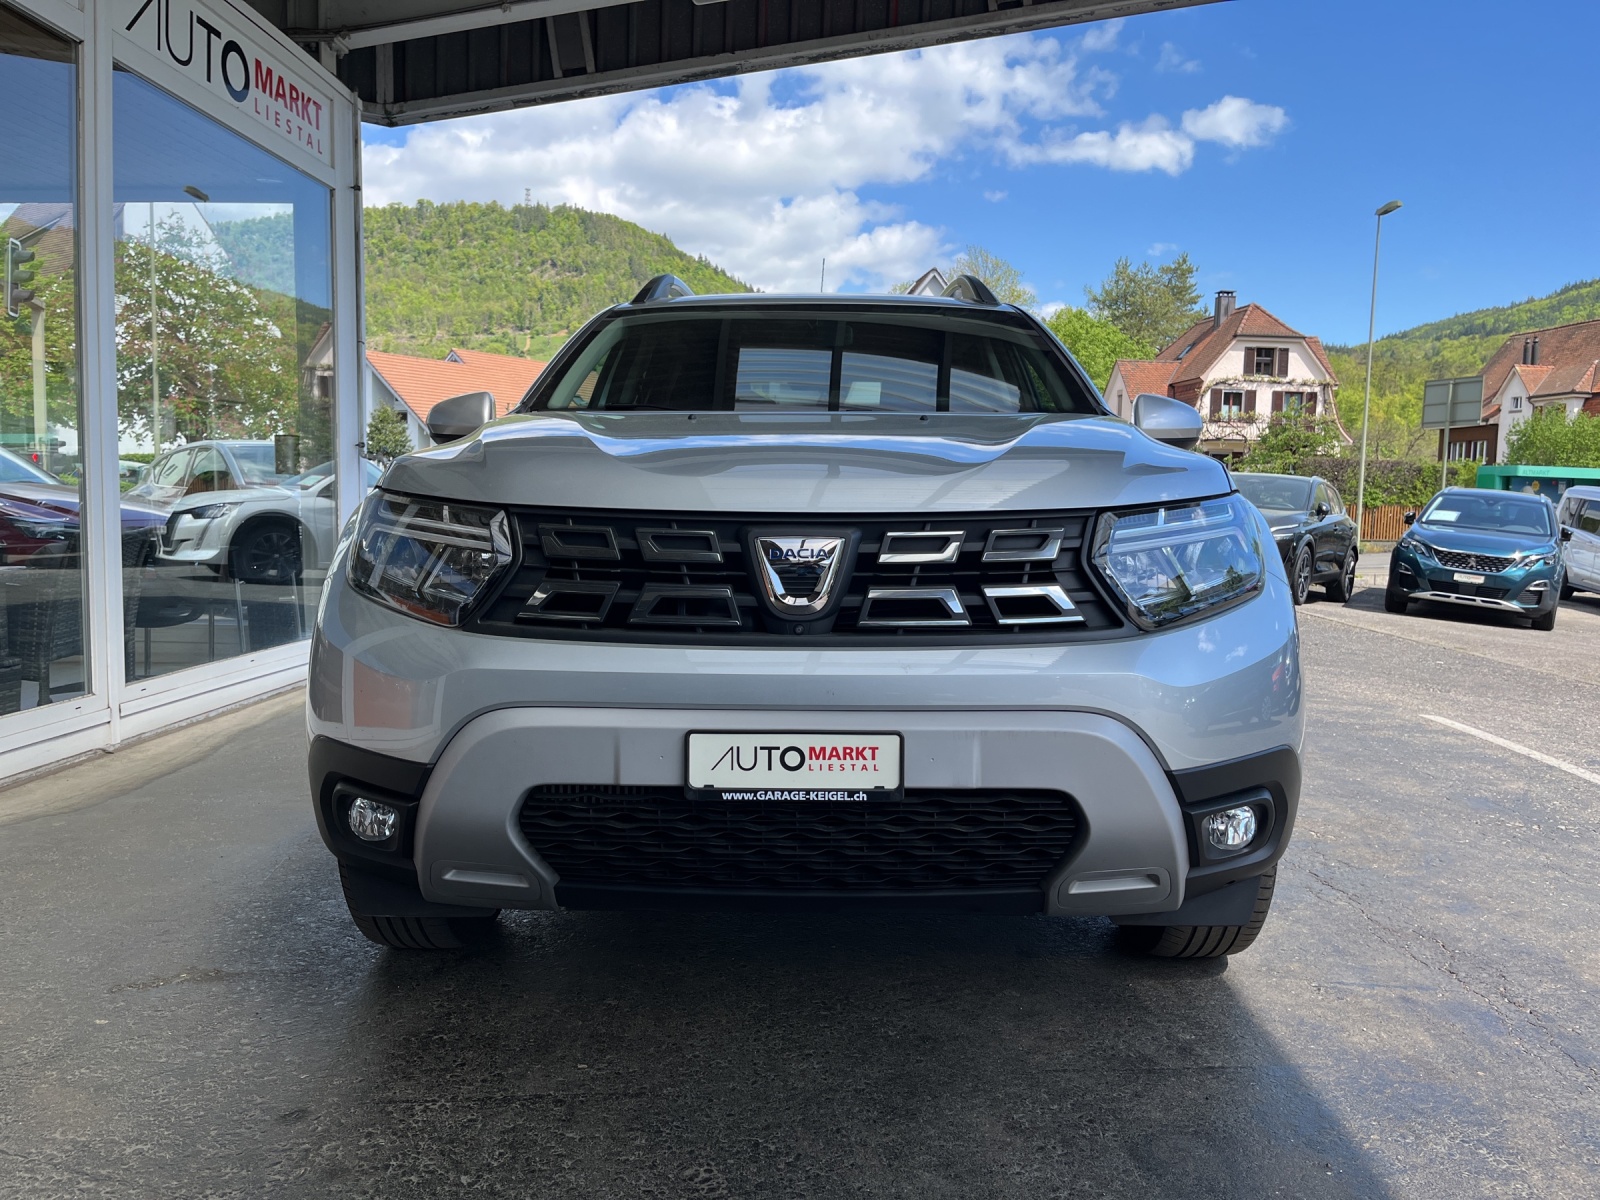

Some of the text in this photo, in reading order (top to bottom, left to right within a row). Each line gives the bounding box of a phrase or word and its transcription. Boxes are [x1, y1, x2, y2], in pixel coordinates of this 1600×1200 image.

[254, 57, 322, 131] MARKT
[254, 97, 323, 155] LIESTAL
[769, 548, 829, 560] DACIA
[808, 763, 879, 772] LIESTAL
[721, 790, 867, 801] www.GARAGE-KEIGEL.ch
